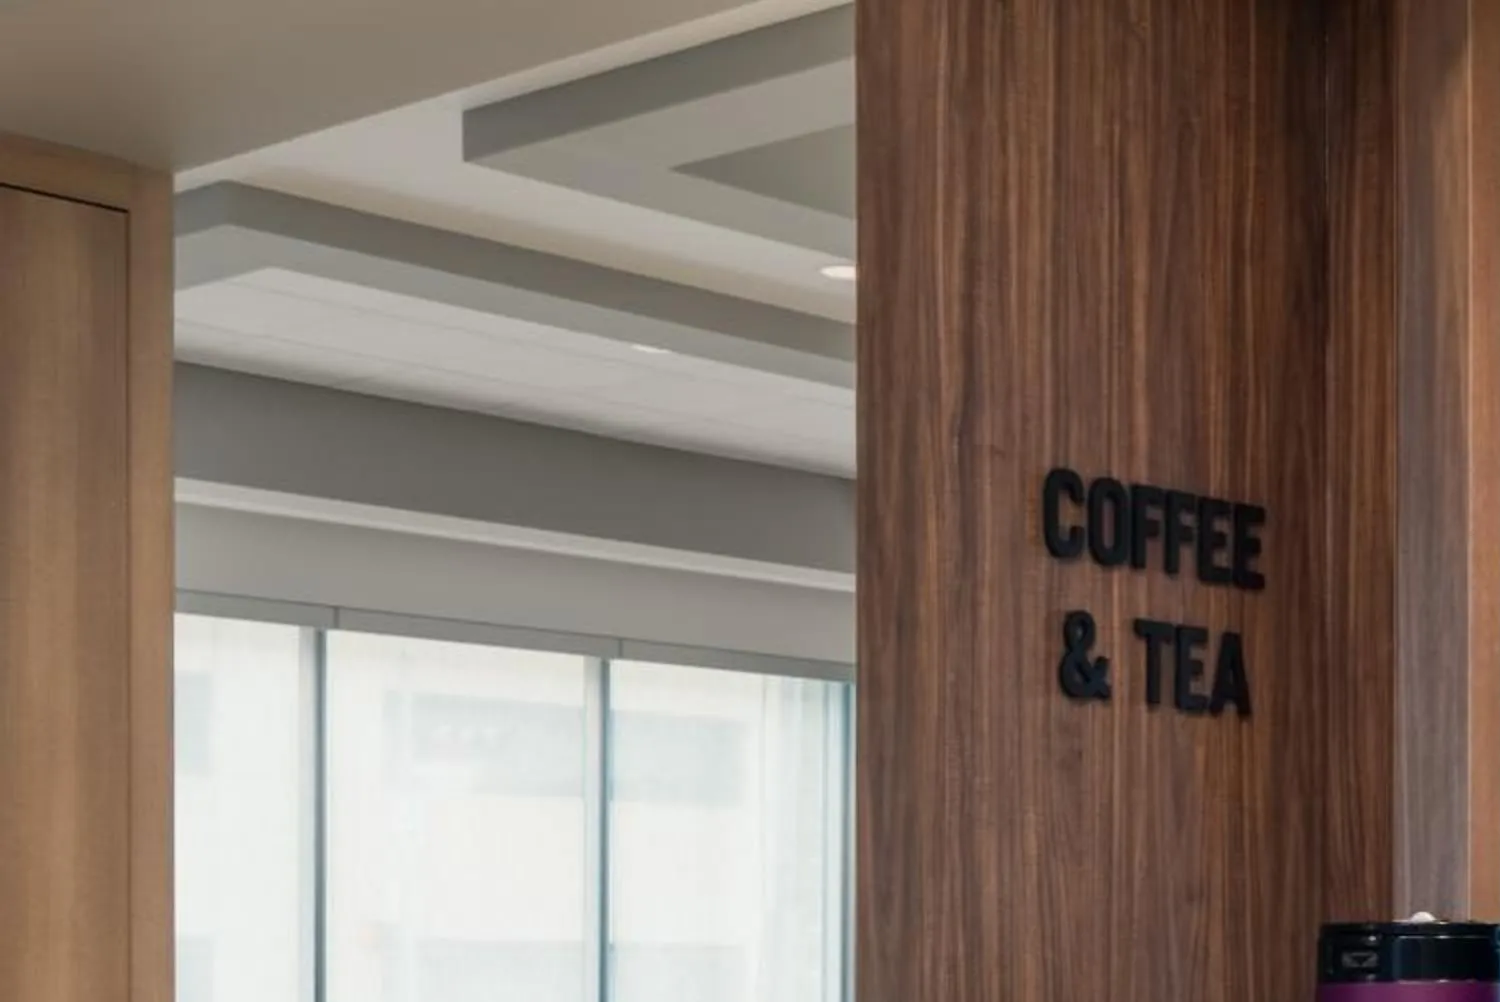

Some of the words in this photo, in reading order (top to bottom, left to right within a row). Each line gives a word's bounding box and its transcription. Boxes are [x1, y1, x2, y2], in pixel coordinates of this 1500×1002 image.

[1043, 468, 1265, 590] COFFEE
[1060, 610, 1110, 701] &
[1133, 618, 1251, 720] TEA
